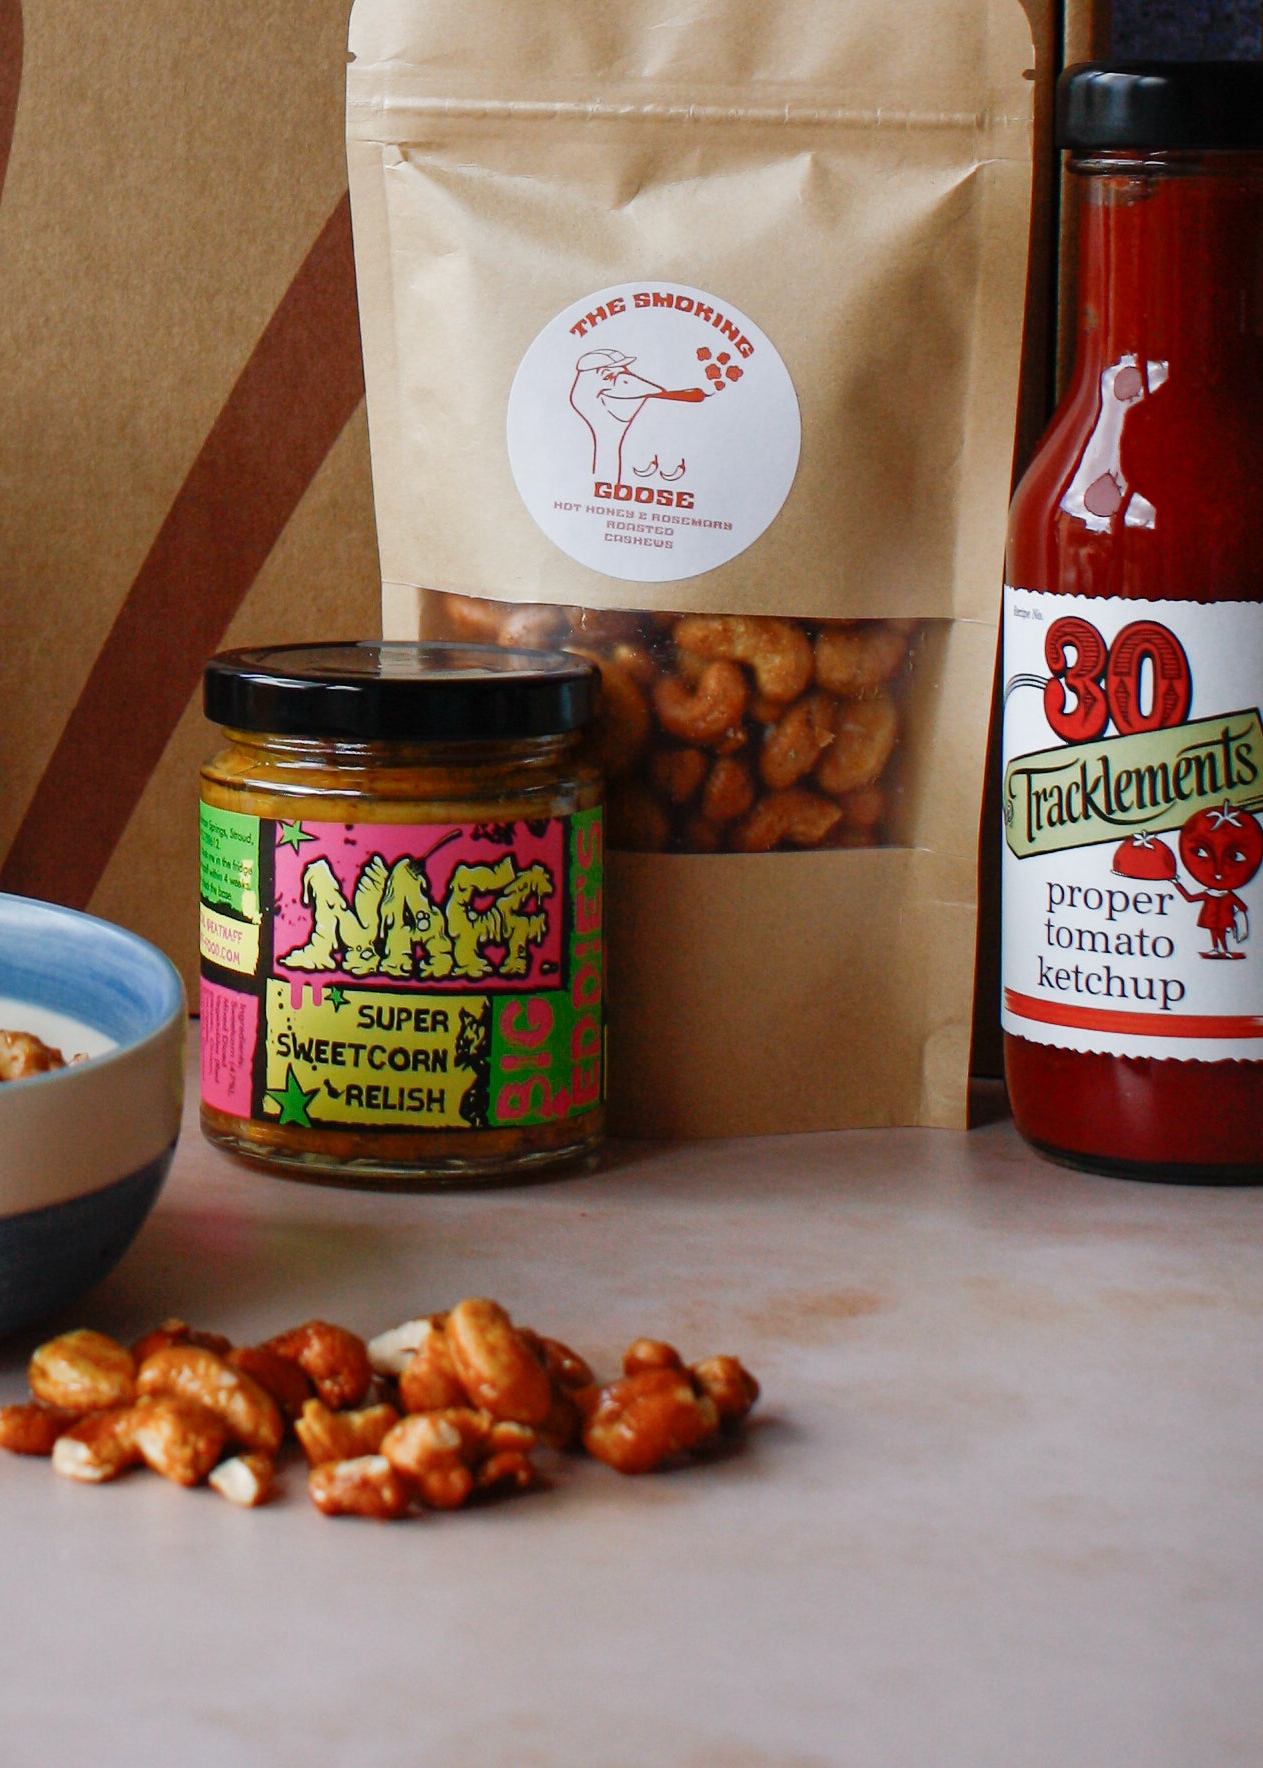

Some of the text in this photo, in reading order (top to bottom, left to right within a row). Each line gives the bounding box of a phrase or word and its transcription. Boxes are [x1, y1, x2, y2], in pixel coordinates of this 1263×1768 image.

[569, 291, 755, 359] THE SMOKING
[553, 500, 582, 512] HOT
[586, 504, 635, 520] HONEY
[651, 513, 733, 531] ROSEMARY
[594, 481, 695, 509] GOOSE
[604, 532, 674, 549] CASHEWS
[606, 520, 675, 536] ROASTED
[1043, 616, 1191, 743] 30
[1009, 720, 1259, 843] Tracklements
[277, 856, 555, 979] NAFF
[1046, 880, 1175, 921] proper
[1044, 916, 1176, 960] tomato
[571, 820, 603, 1106] EDDIE'S
[1037, 955, 1187, 1011] ketchup
[358, 1003, 449, 1033] SUPER
[276, 1031, 448, 1073] SWEETCORN
[498, 997, 554, 1121] BIG
[345, 1084, 446, 1113] RELISH
